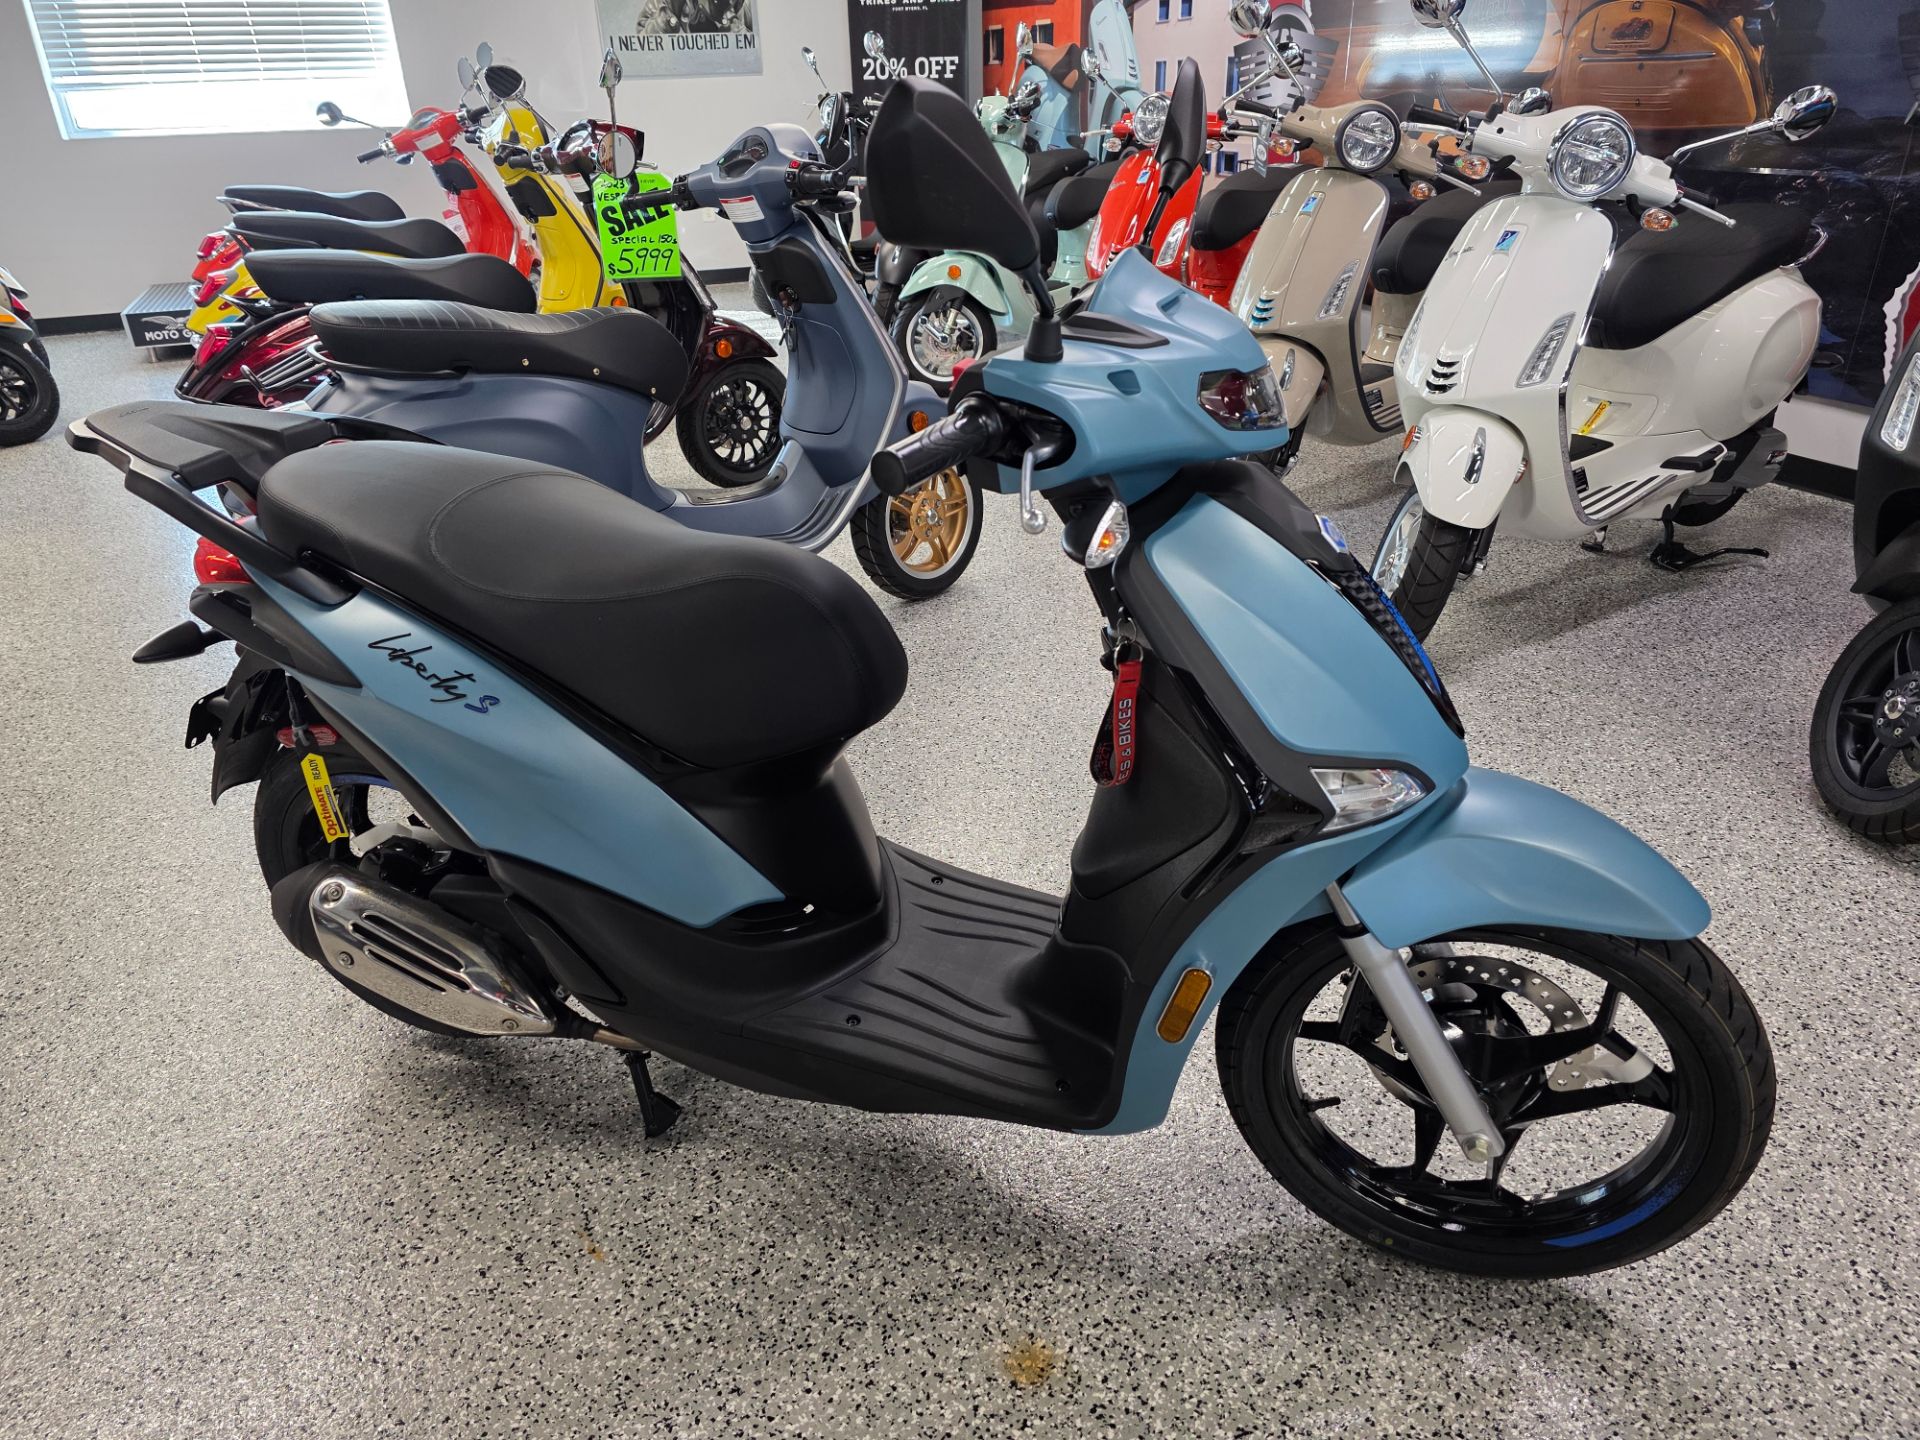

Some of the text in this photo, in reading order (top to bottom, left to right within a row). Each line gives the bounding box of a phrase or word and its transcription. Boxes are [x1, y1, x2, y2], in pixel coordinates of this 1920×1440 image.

[609, 34, 756, 51] I NEVER TOUCHED EM
[862, 56, 959, 80] 20% OFF
[597, 192, 625, 202] VESP
[611, 236, 655, 245] SPECIAL
[144, 330, 180, 342] MOTO
[367, 632, 477, 703] Liberty
[1118, 698, 1132, 746] BIKES
[1121, 747, 1132, 756] &
[308, 759, 322, 780] READY
